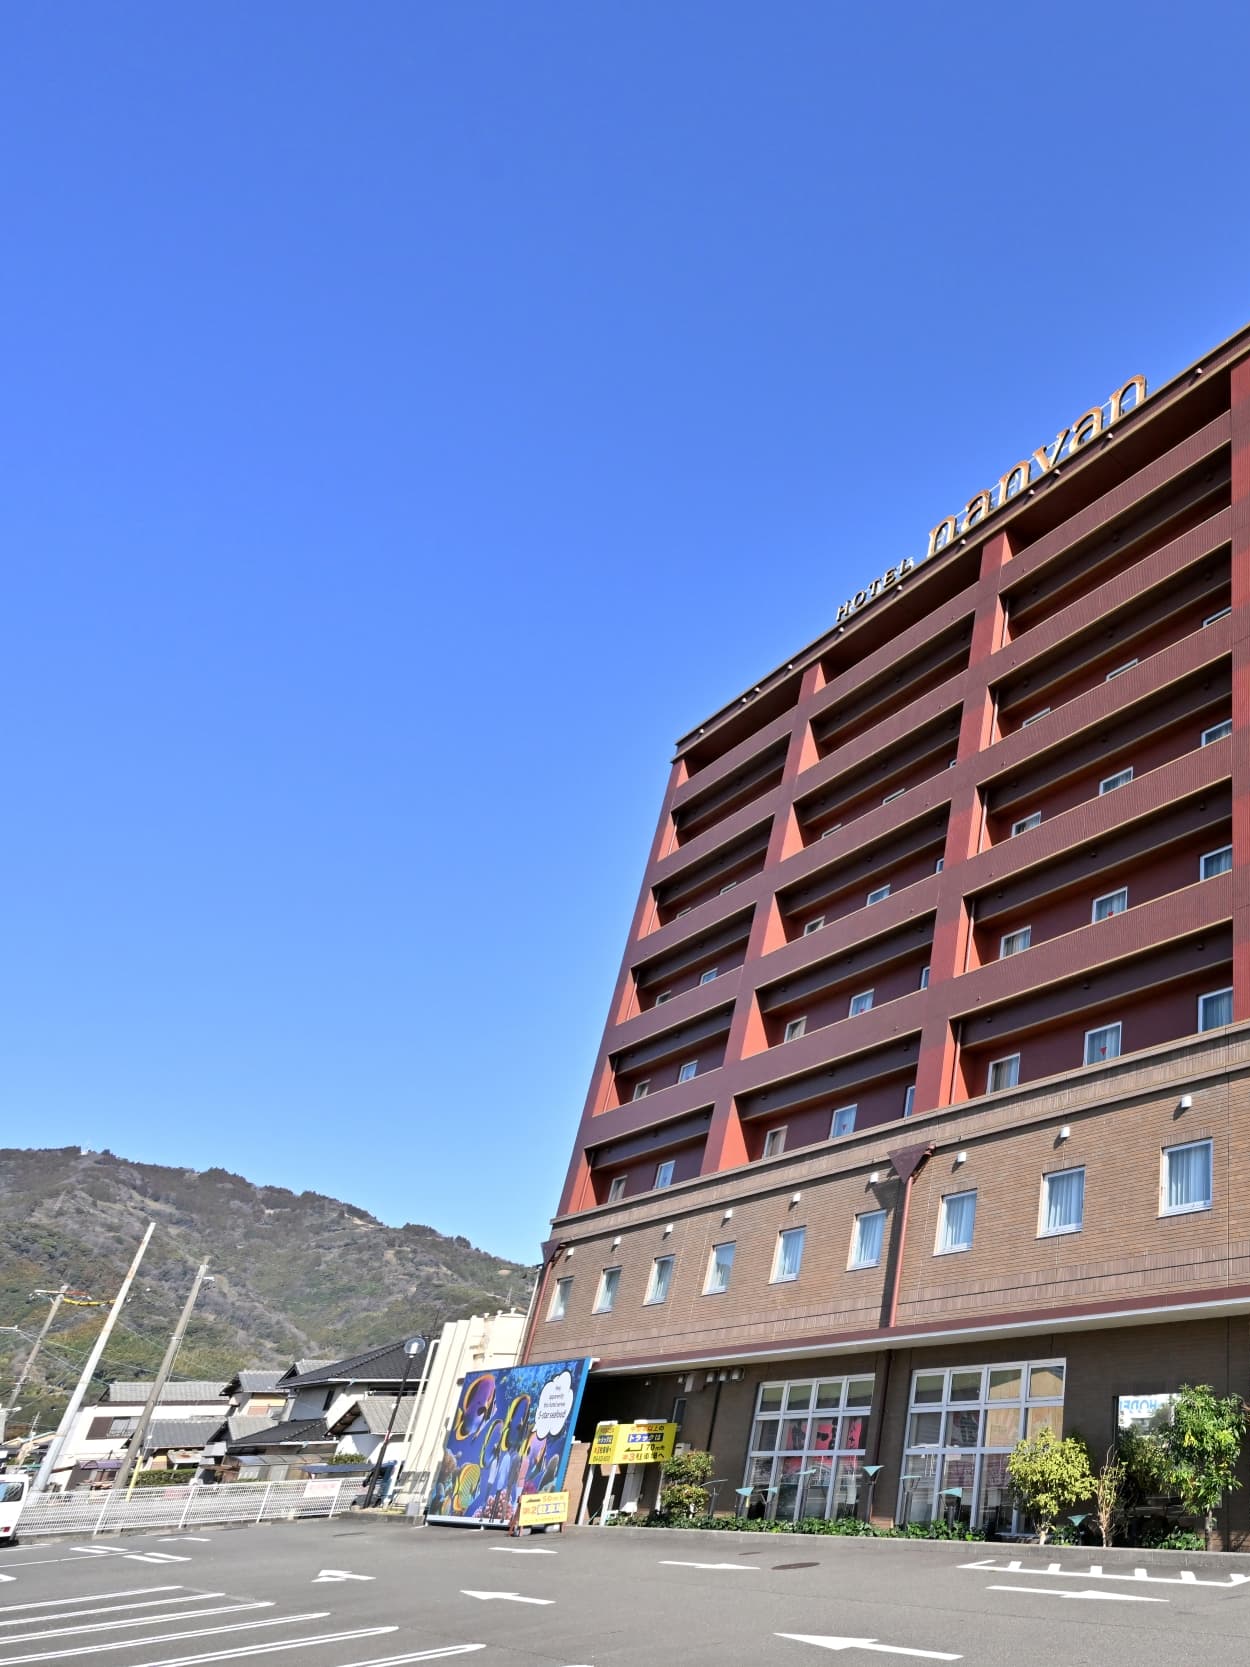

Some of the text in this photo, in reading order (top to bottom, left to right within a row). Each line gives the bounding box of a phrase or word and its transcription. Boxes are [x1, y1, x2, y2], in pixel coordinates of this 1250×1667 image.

[927, 374, 1147, 558] nanvan
[836, 557, 914, 622] HOTEL
[629, 1433, 662, 1442] トラックは
